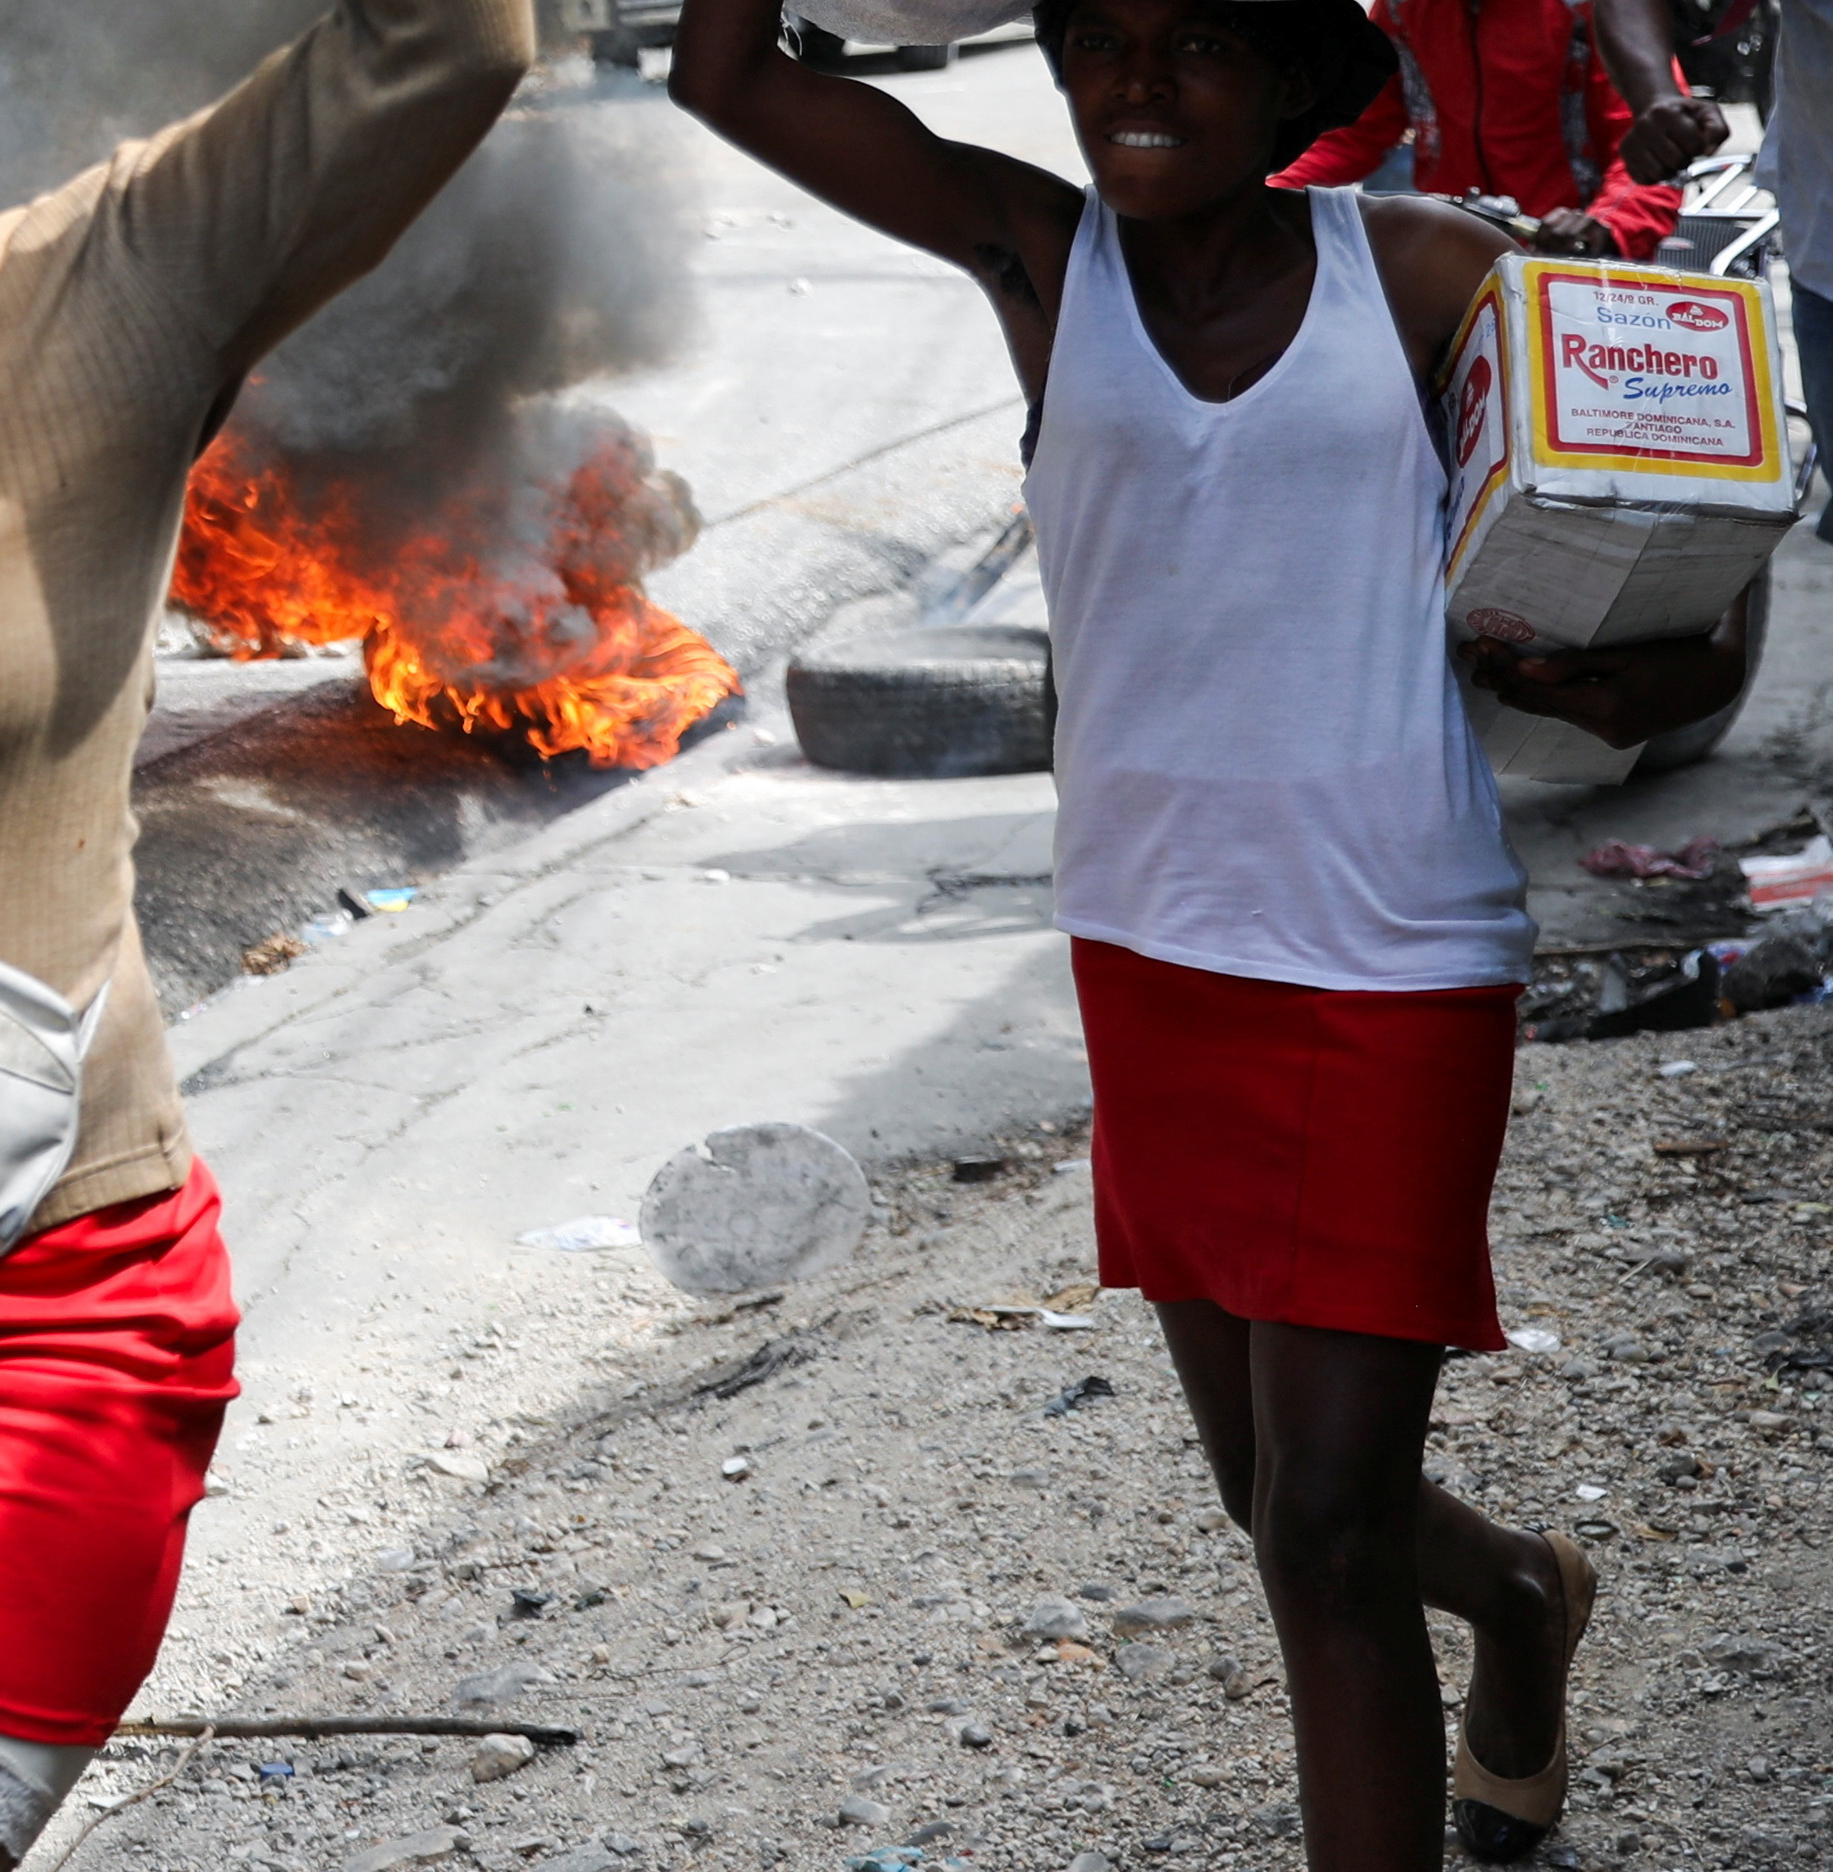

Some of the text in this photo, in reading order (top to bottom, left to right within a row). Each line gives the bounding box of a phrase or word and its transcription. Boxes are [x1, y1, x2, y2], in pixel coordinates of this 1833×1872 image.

[1596, 306, 1671, 330] Sazón
[1561, 334, 1719, 390] Ranchero
[1623, 377, 1732, 404] Supremo
[1571, 408, 1634, 420] BALTIMORE
[1637, 413, 1712, 428] DOMINICANA,
[1587, 427, 1724, 447] REPUBLICA DOMINICANA
